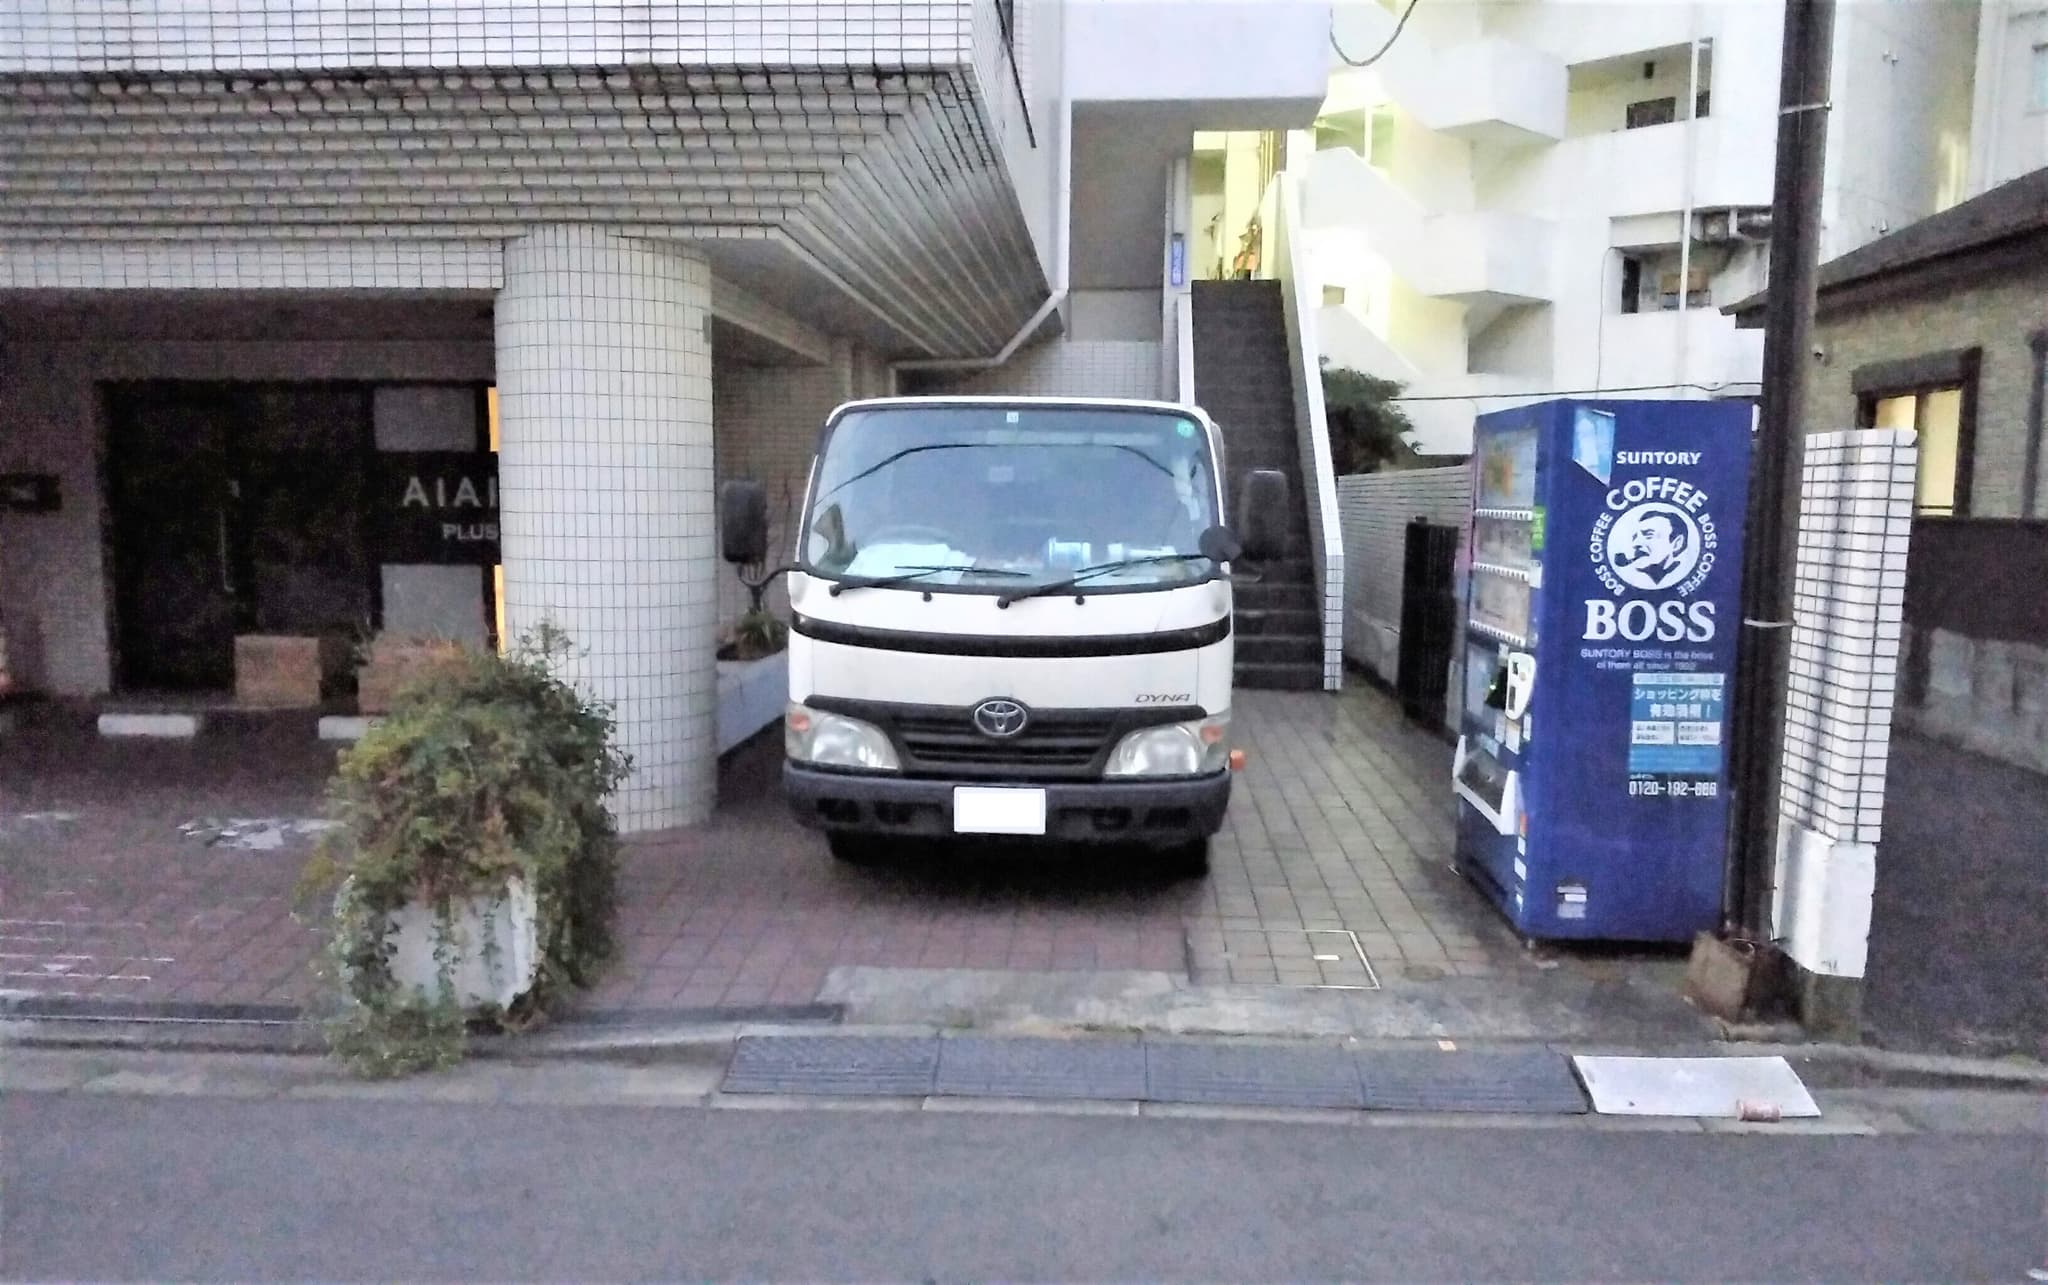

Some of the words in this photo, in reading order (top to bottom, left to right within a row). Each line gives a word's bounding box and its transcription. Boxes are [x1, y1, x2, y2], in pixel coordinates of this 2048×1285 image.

[403, 476, 497, 507] AIAI
[1606, 476, 1708, 513] COFFEE
[442, 523, 498, 540] PLUS
[1590, 512, 1613, 562] COFFEE
[1697, 513, 1717, 549] BOSS
[1595, 565, 1625, 596] BOSS
[1677, 553, 1715, 597] COFFEE
[1582, 599, 1716, 642] BOSS
[1580, 648, 1631, 658] SUNTORY
[1135, 693, 1190, 703] DYNA
